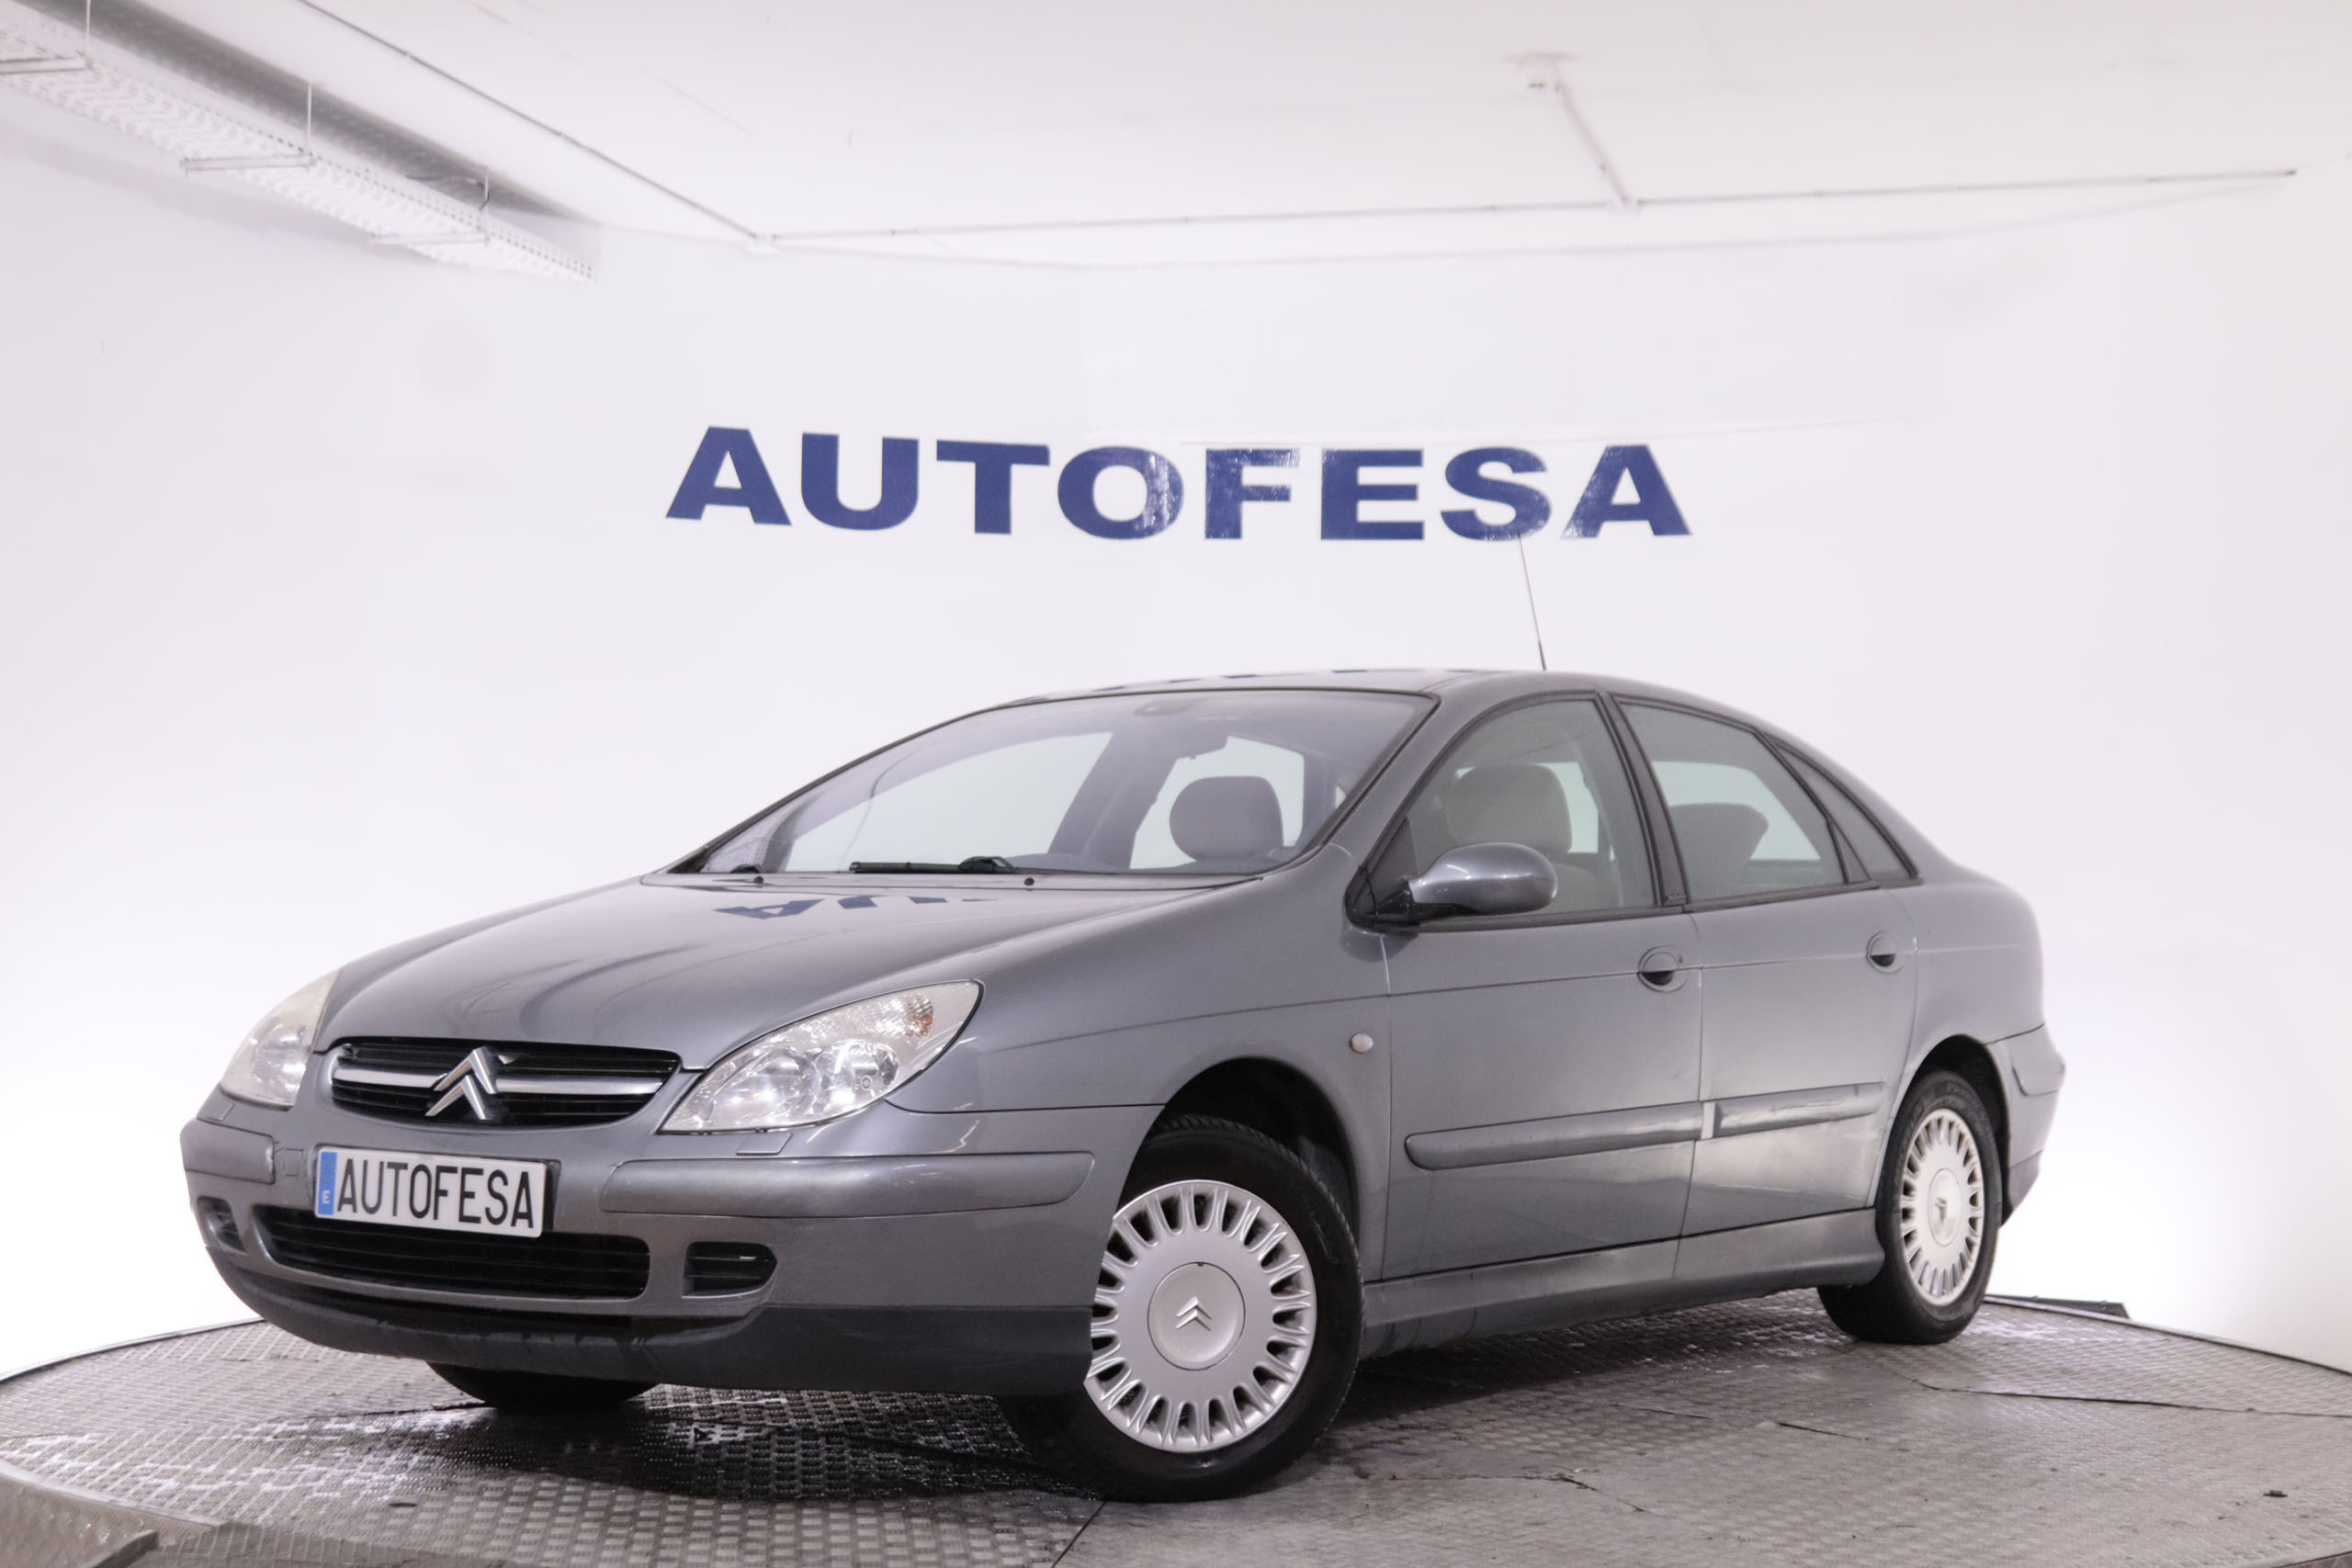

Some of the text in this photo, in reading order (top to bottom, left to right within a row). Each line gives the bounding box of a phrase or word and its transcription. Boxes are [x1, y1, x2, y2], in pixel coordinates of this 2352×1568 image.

[666, 426, 1690, 541] AUTOFESA
[322, 1190, 331, 1204] E
[337, 1158, 534, 1229] AUTOFESA
